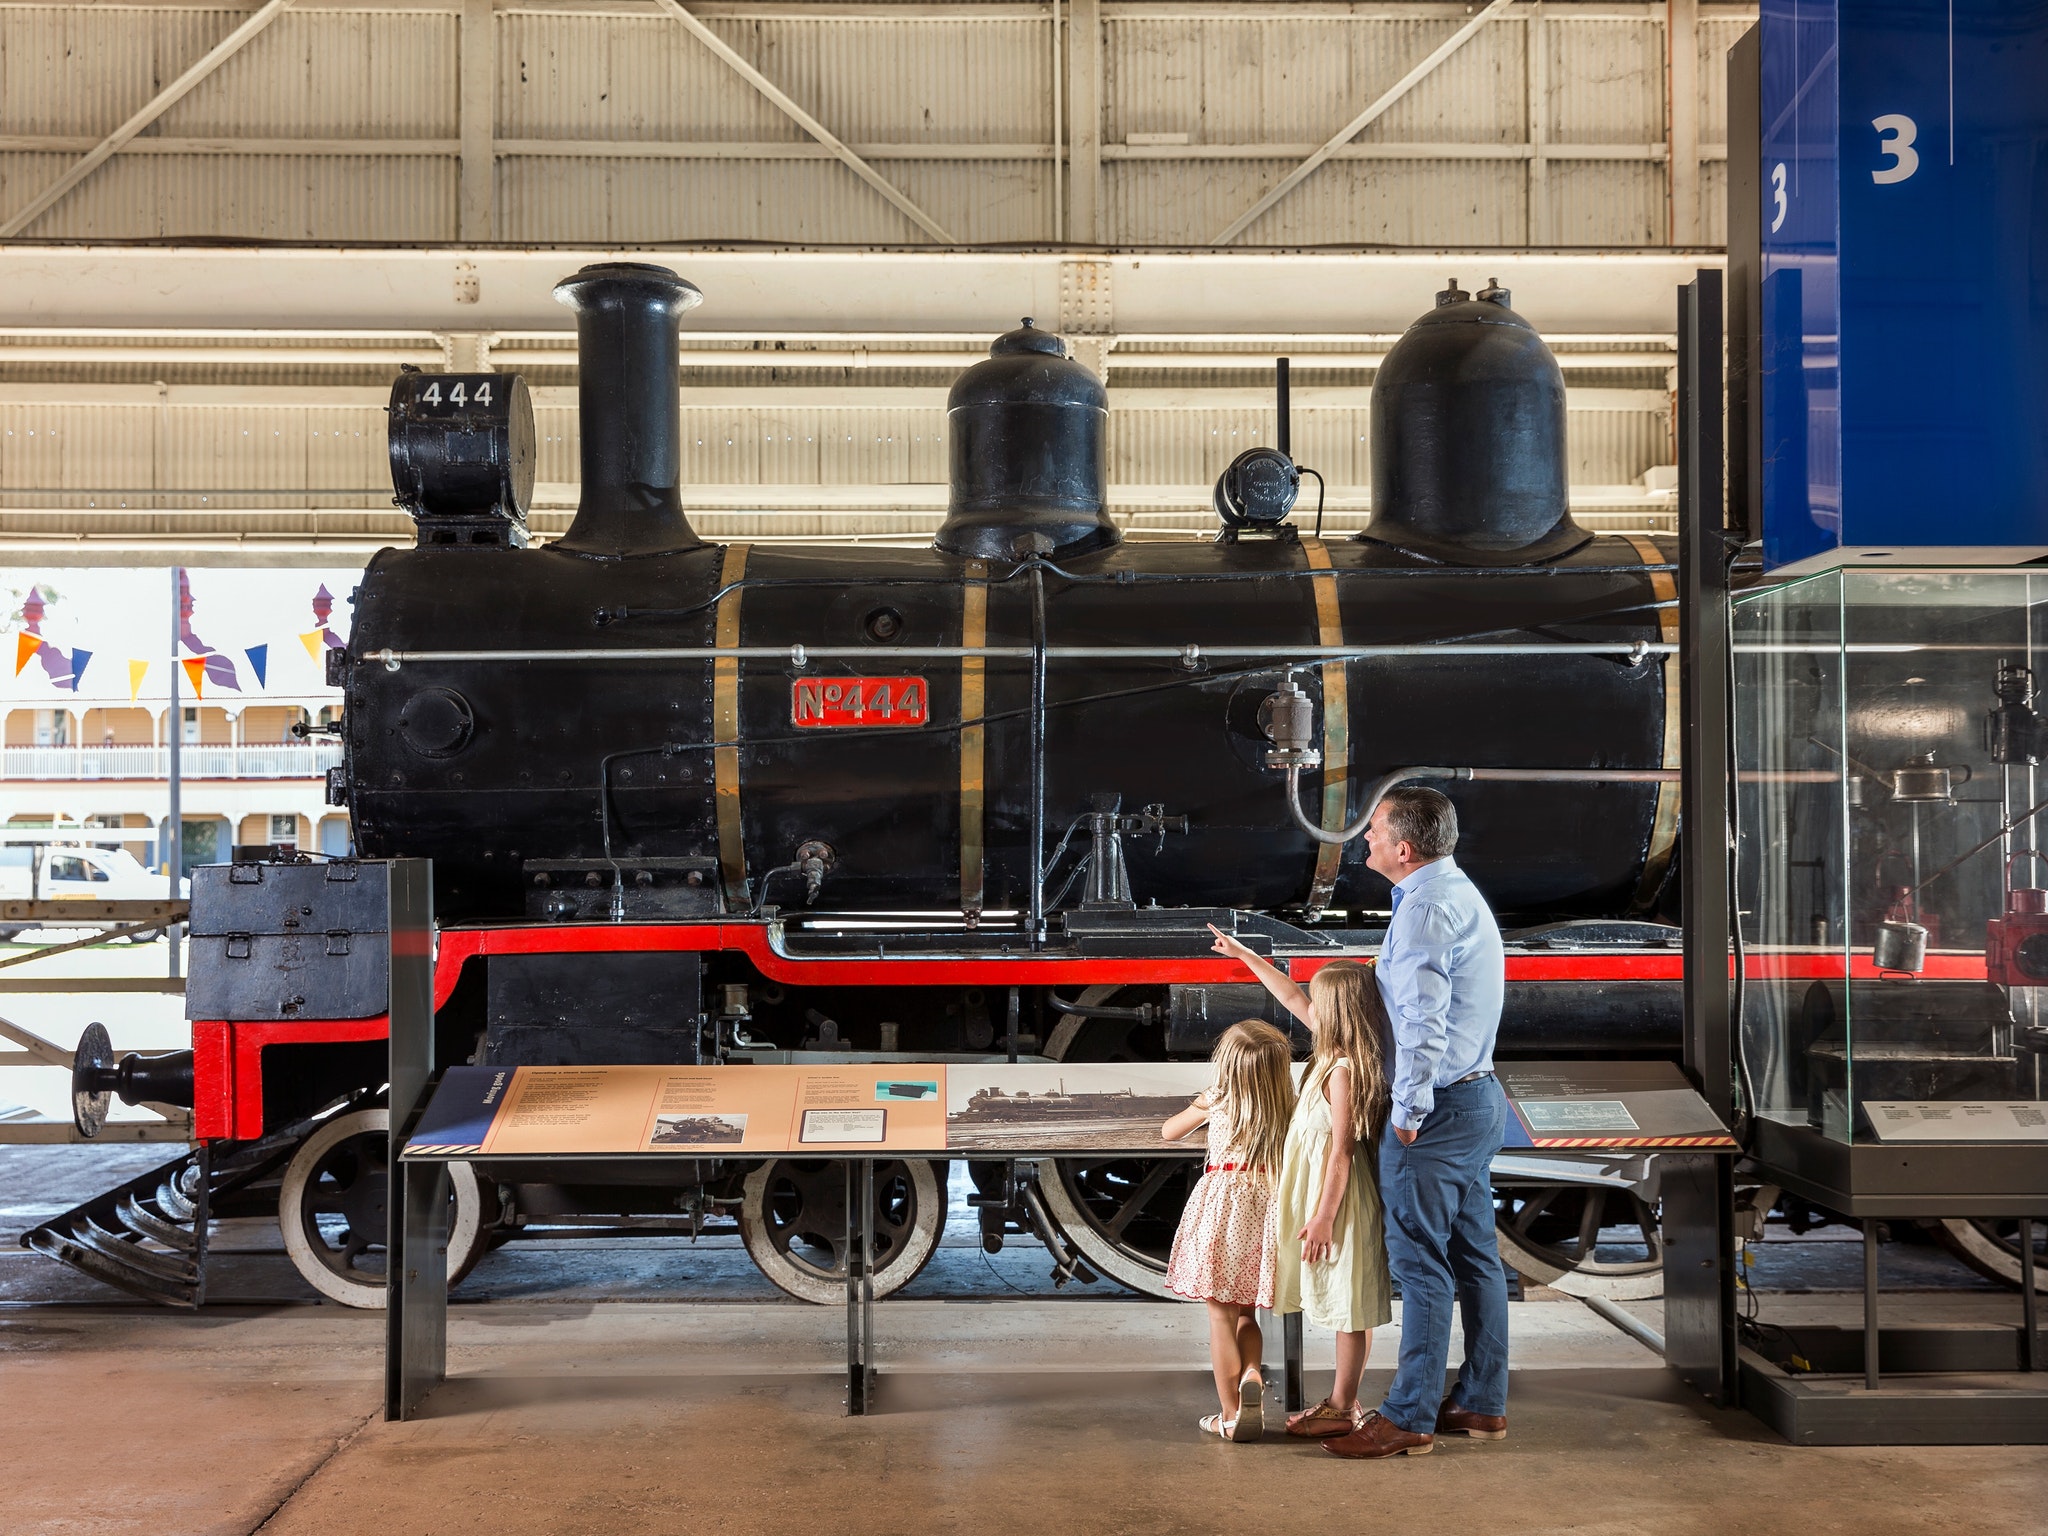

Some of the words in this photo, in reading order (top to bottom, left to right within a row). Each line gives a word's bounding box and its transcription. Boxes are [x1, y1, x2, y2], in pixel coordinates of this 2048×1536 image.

[1871, 113, 1920, 185] 3
[1770, 161, 1788, 234] 3
[421, 381, 494, 408] 444
[482, 1086, 502, 1104] Moving
[493, 1072, 506, 1086] goods
